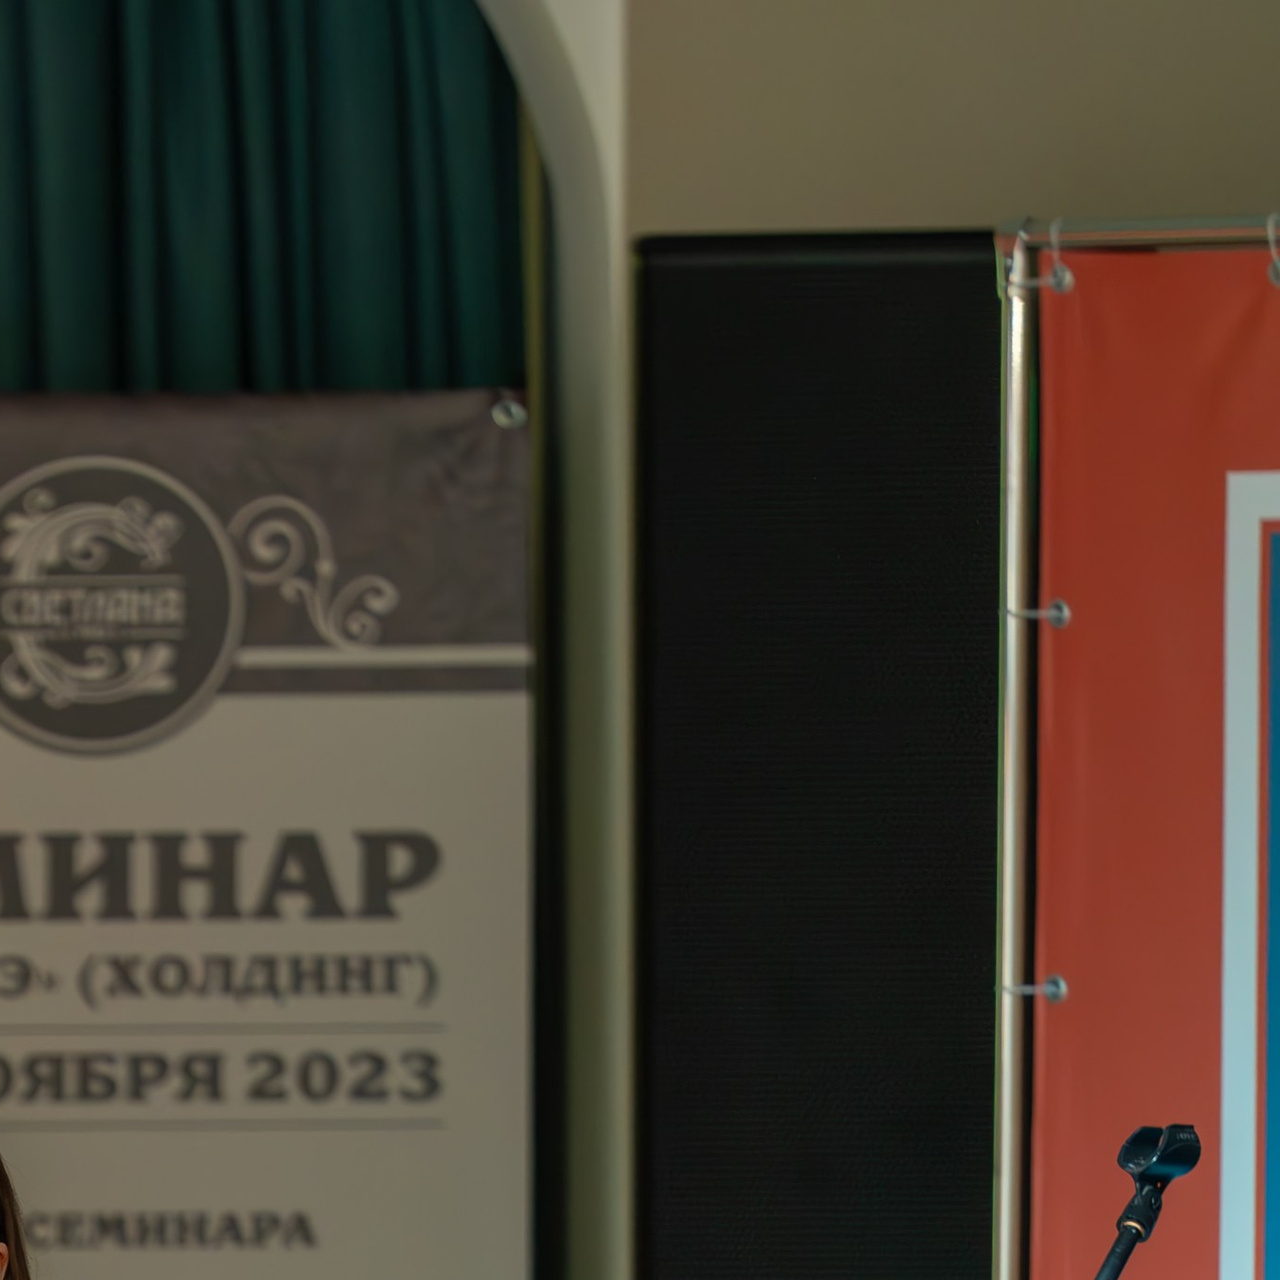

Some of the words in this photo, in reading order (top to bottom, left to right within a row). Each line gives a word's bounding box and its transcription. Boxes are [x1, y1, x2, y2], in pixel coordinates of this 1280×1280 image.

[77, 951, 440, 1010] (ХОЛДИНГ)
[244, 1052, 442, 1102] 2023
[22, 1211, 317, 1250] СЕМИНАРА
